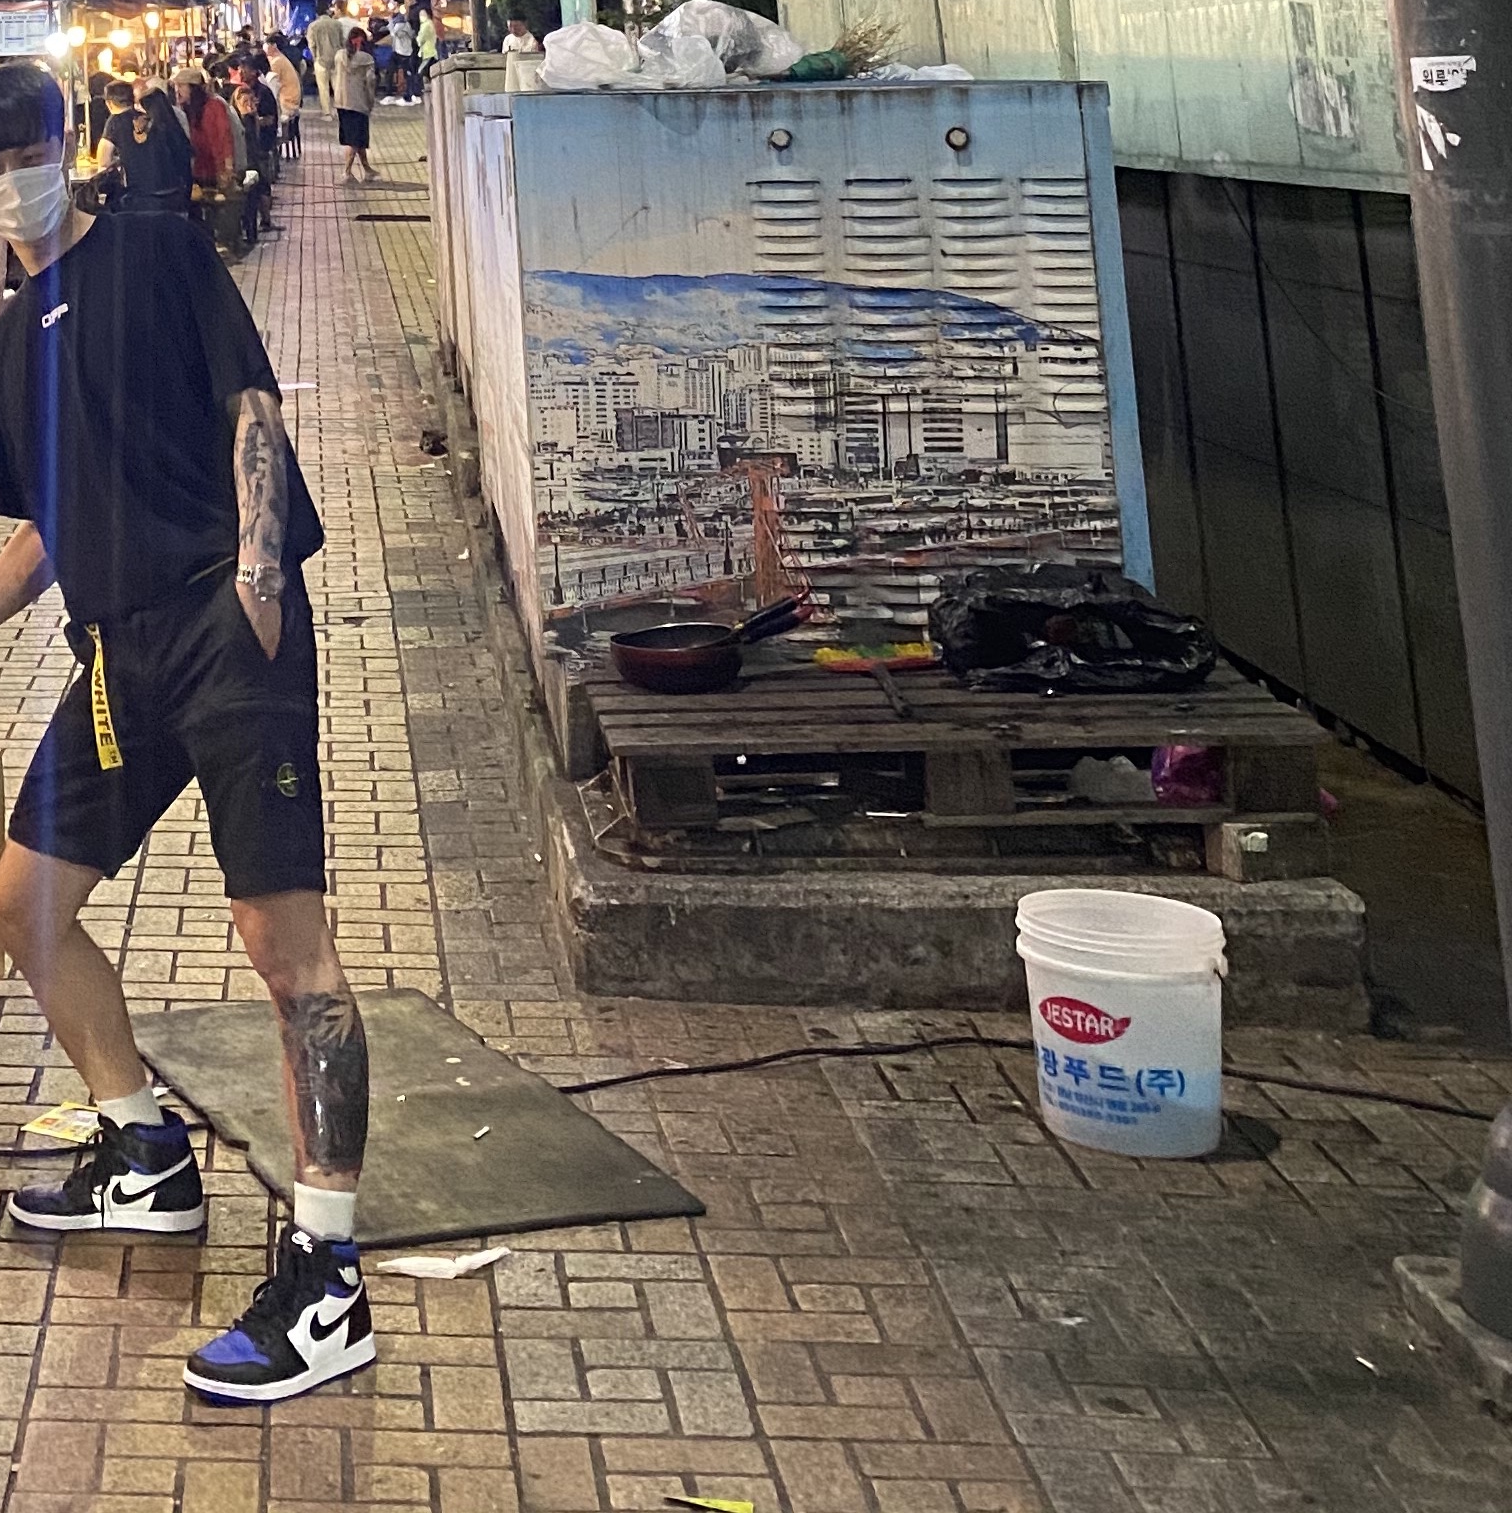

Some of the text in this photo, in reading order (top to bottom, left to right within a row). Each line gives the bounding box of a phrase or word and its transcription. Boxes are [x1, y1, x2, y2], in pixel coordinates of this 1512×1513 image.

[93, 668, 115, 747] WHITE
[1045, 1001, 1116, 1038] JESTAR
[1034, 1043, 1186, 1099] 광푸드(주)
